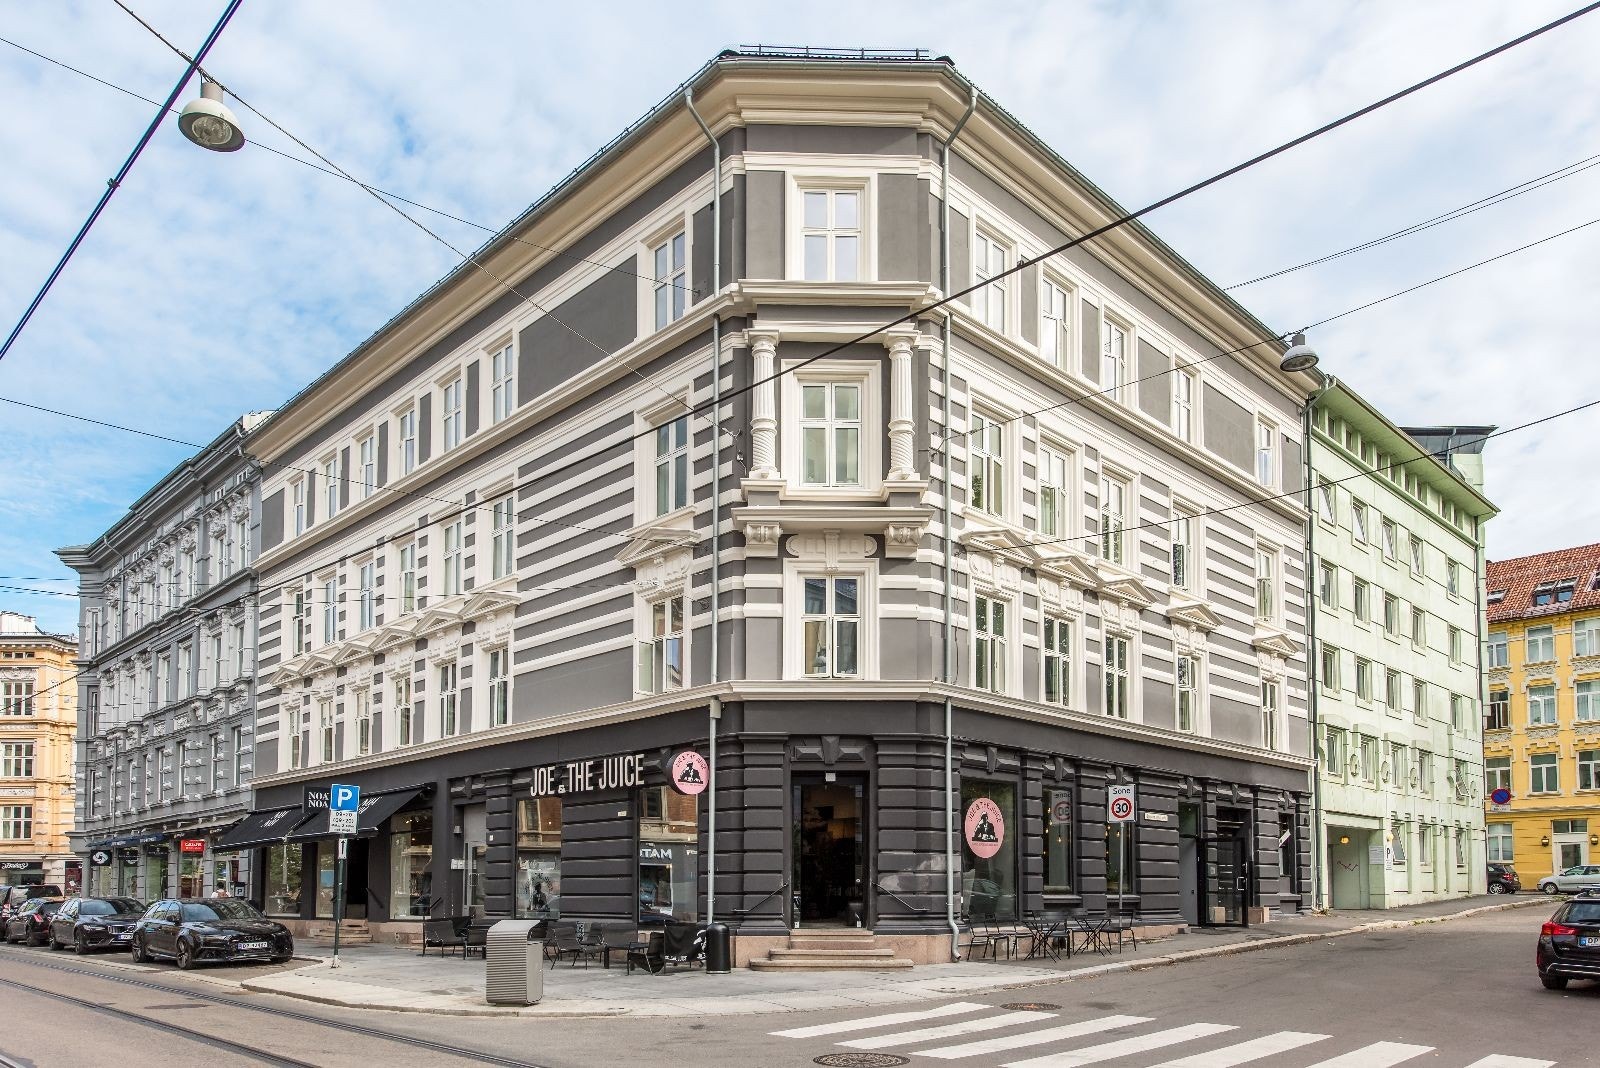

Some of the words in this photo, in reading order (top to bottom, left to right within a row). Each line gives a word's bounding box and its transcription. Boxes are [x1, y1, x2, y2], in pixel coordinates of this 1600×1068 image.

[530, 765, 556, 797] JOE
[557, 784, 566, 794] &
[567, 760, 593, 793] THE
[598, 753, 645, 790] JUICE
[308, 791, 329, 800] NOA
[1112, 787, 1131, 795] Sone
[337, 788, 353, 808] P
[308, 799, 329, 808] NOA
[1115, 802, 1129, 814] 30
